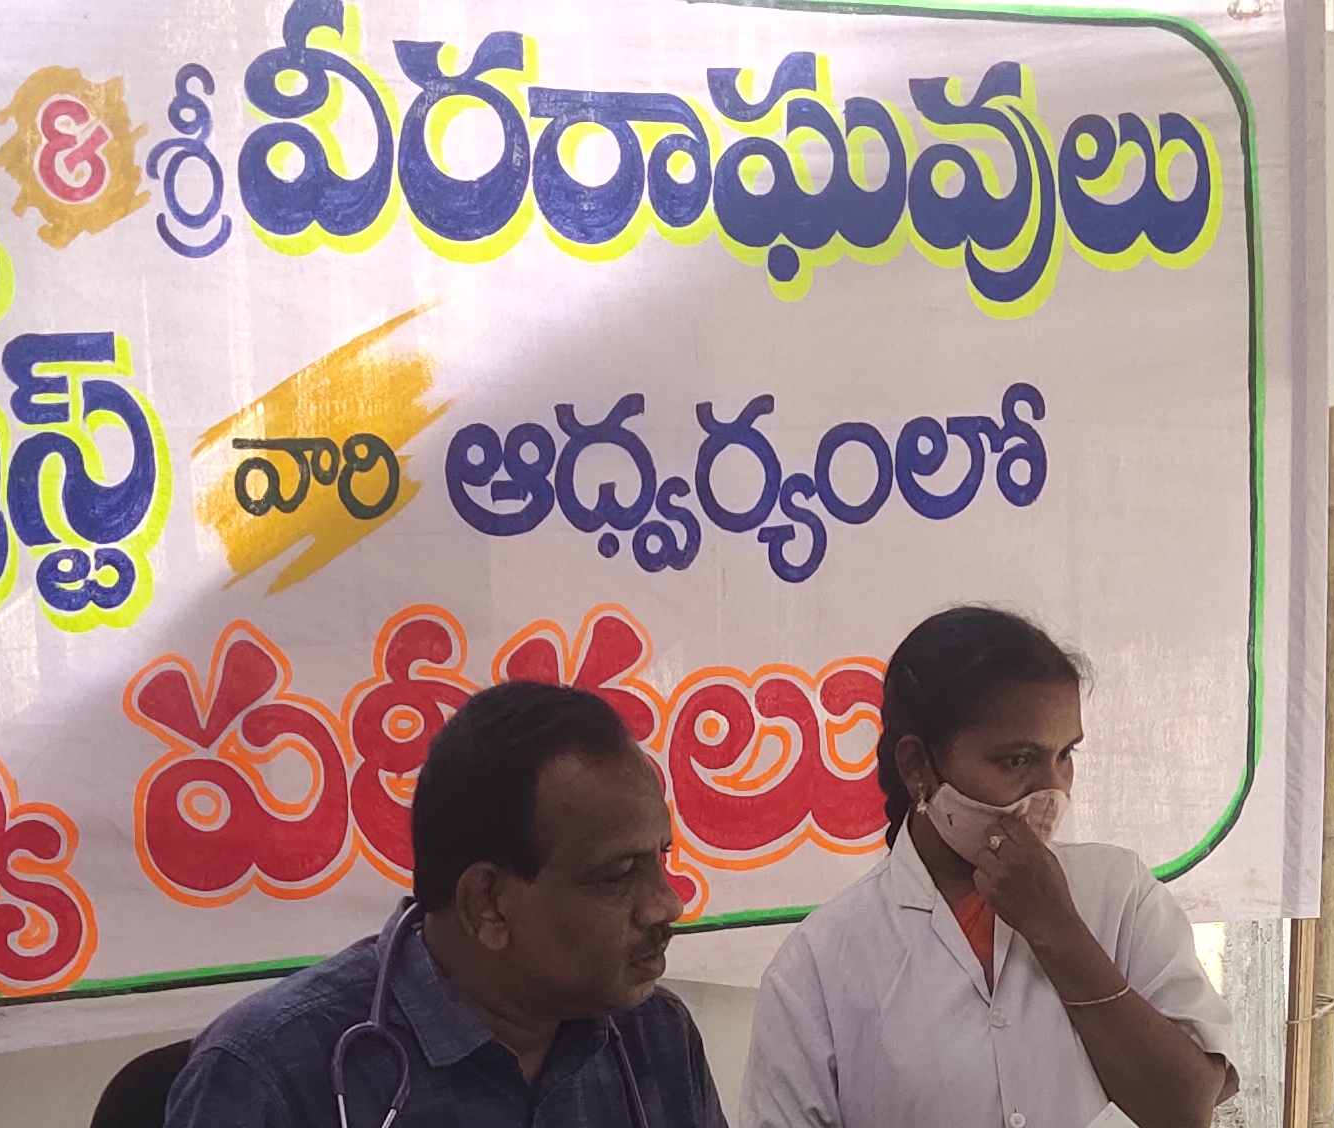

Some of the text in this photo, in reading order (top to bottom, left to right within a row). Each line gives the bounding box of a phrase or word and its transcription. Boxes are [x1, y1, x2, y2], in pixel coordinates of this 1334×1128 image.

[38, 98, 111, 203] &
[146, 62, 233, 259] శ్రీ
[237, 0, 1217, 308] వీరరాఘవులు
[232, 431, 401, 520] వారి
[445, 382, 1049, 585] ఆధ్వర్యంలో
